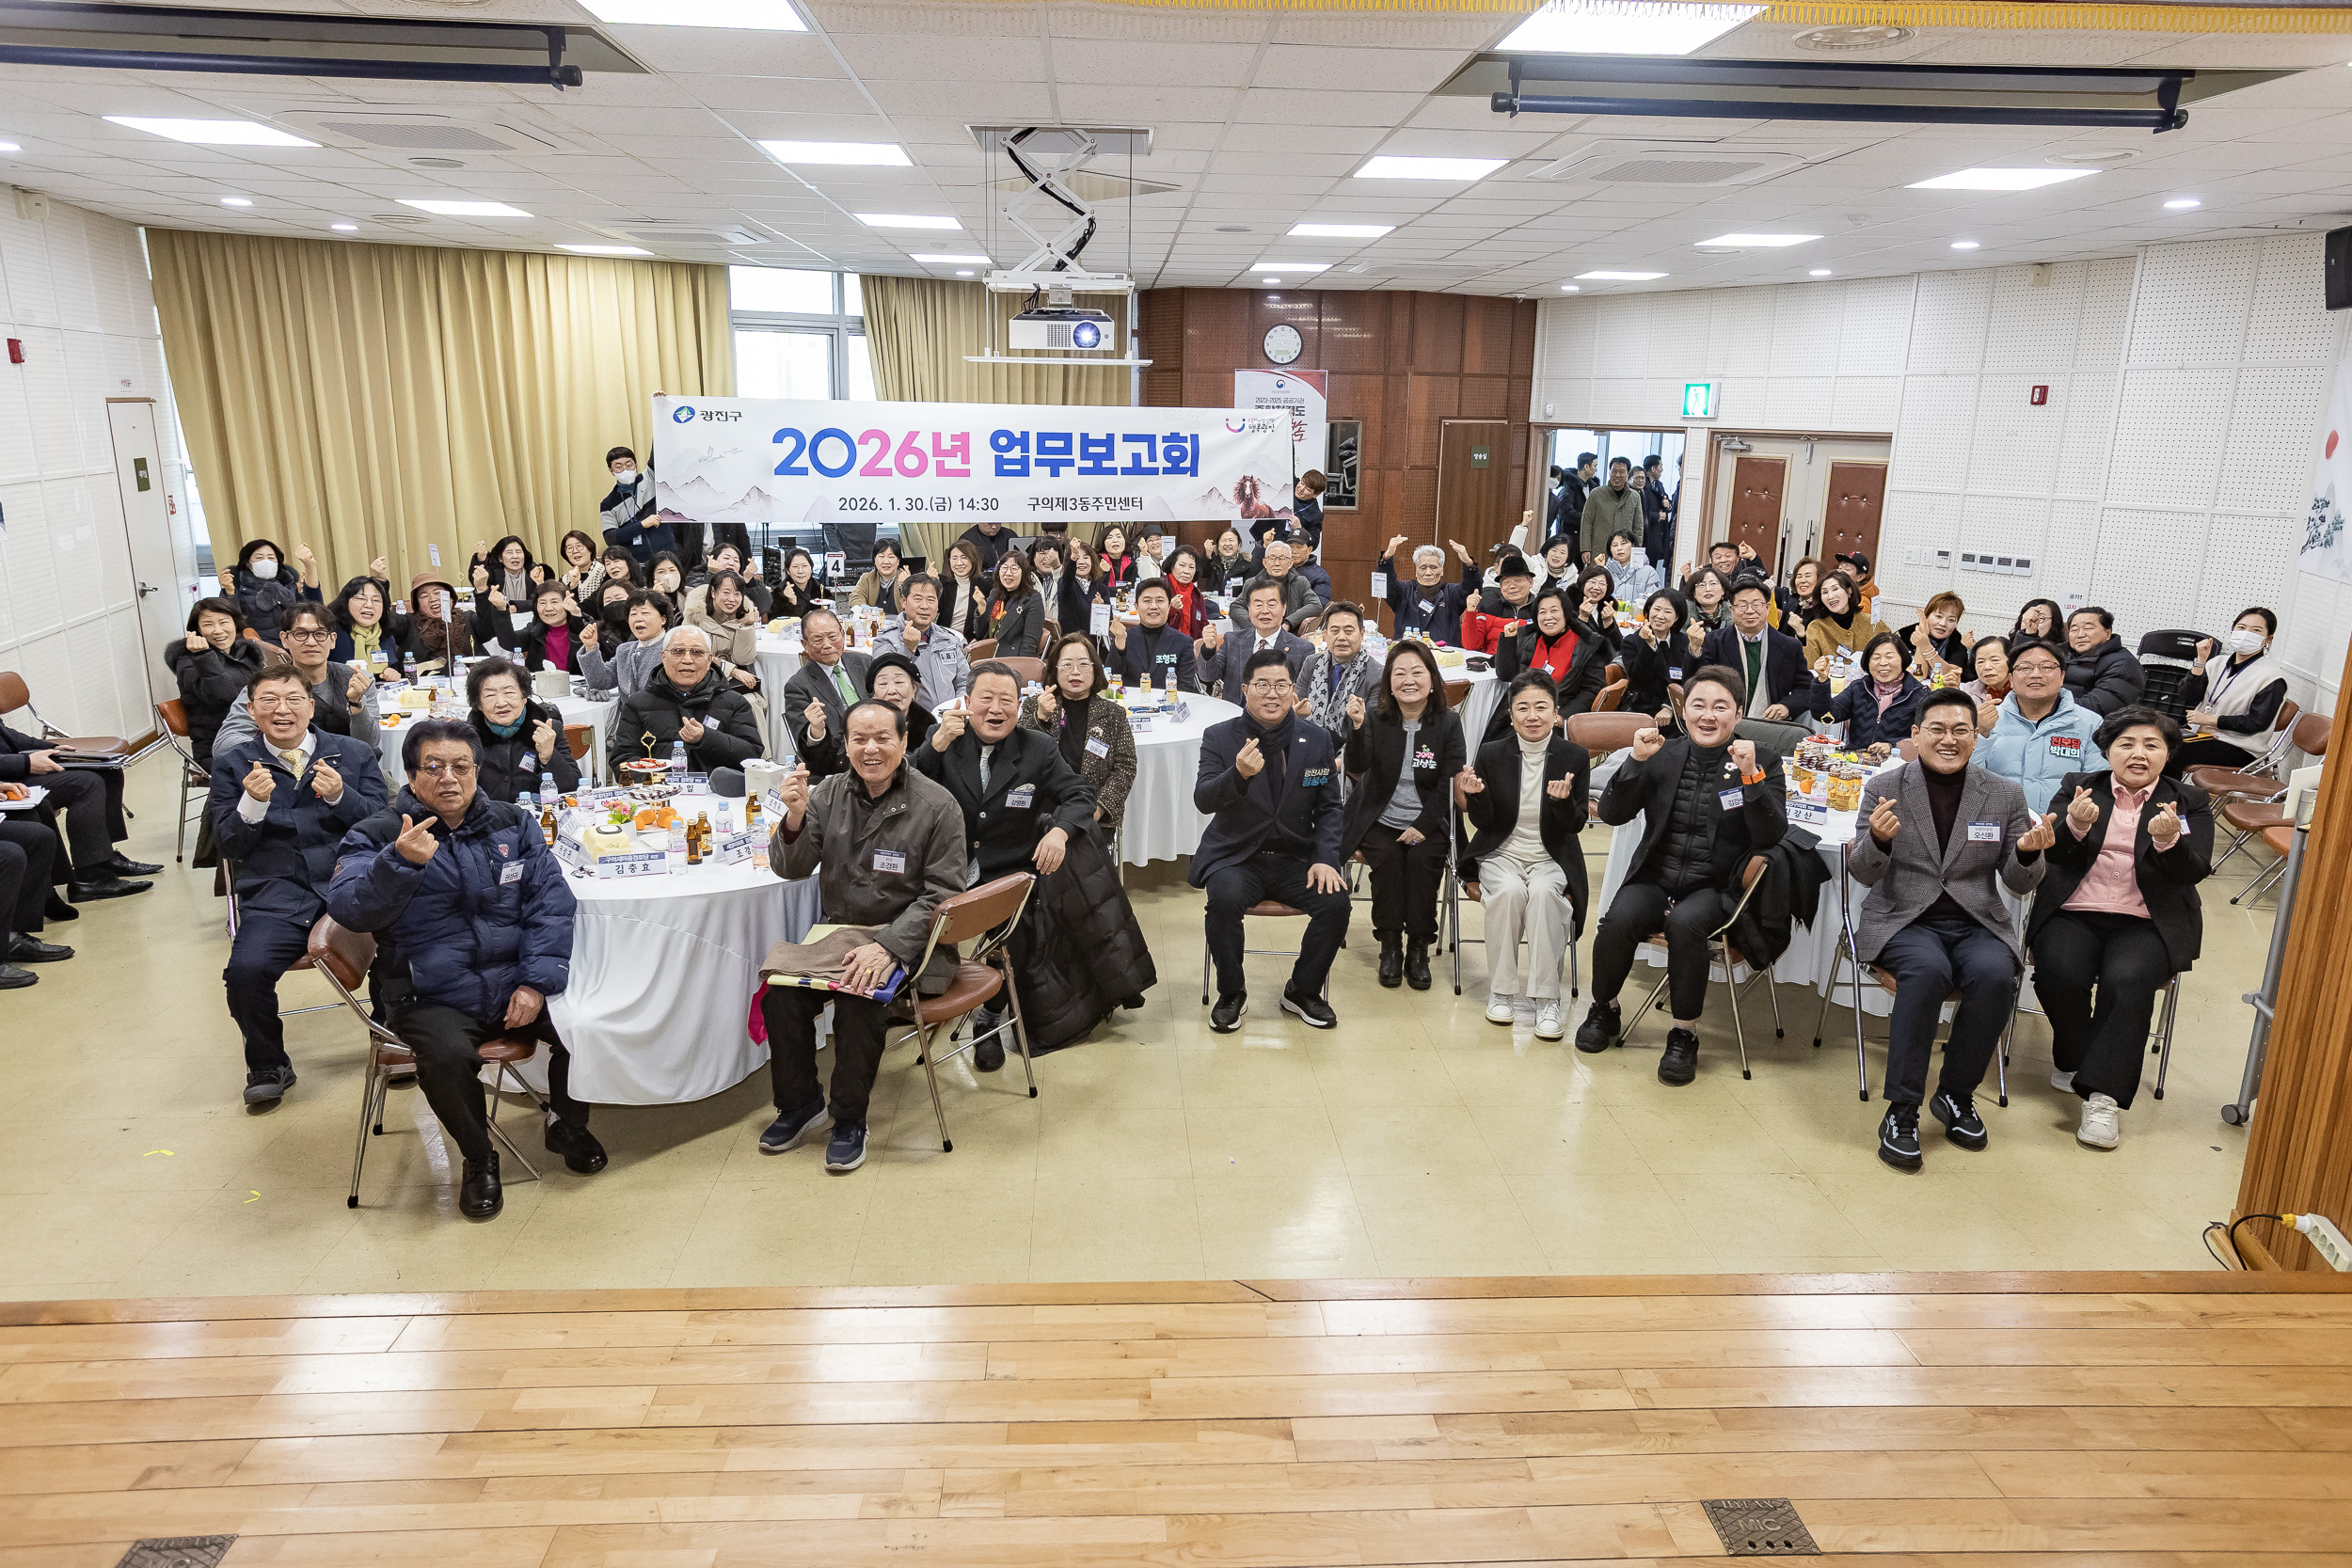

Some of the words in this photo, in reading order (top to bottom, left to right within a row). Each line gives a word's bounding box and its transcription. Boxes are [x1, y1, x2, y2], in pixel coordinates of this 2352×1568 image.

[700, 410, 742, 421] 광진구
[772, 428, 971, 478] 2026년
[990, 429, 1200, 477] 업무보고회
[838, 497, 882, 511] 2026.
[888, 498, 900, 511] 1.
[905, 496, 953, 512] 30.(금)
[958, 498, 999, 511] 14:30
[1027, 497, 1143, 512] 구의제3동주민센터
[832, 560, 840, 572] 4
[1155, 654, 1177, 664] 조형국
[2051, 736, 2081, 749] 진보당
[2050, 746, 2080, 758] 박대희
[1302, 776, 1328, 787] 김성수
[1738, 1518, 1781, 1531] MIC
